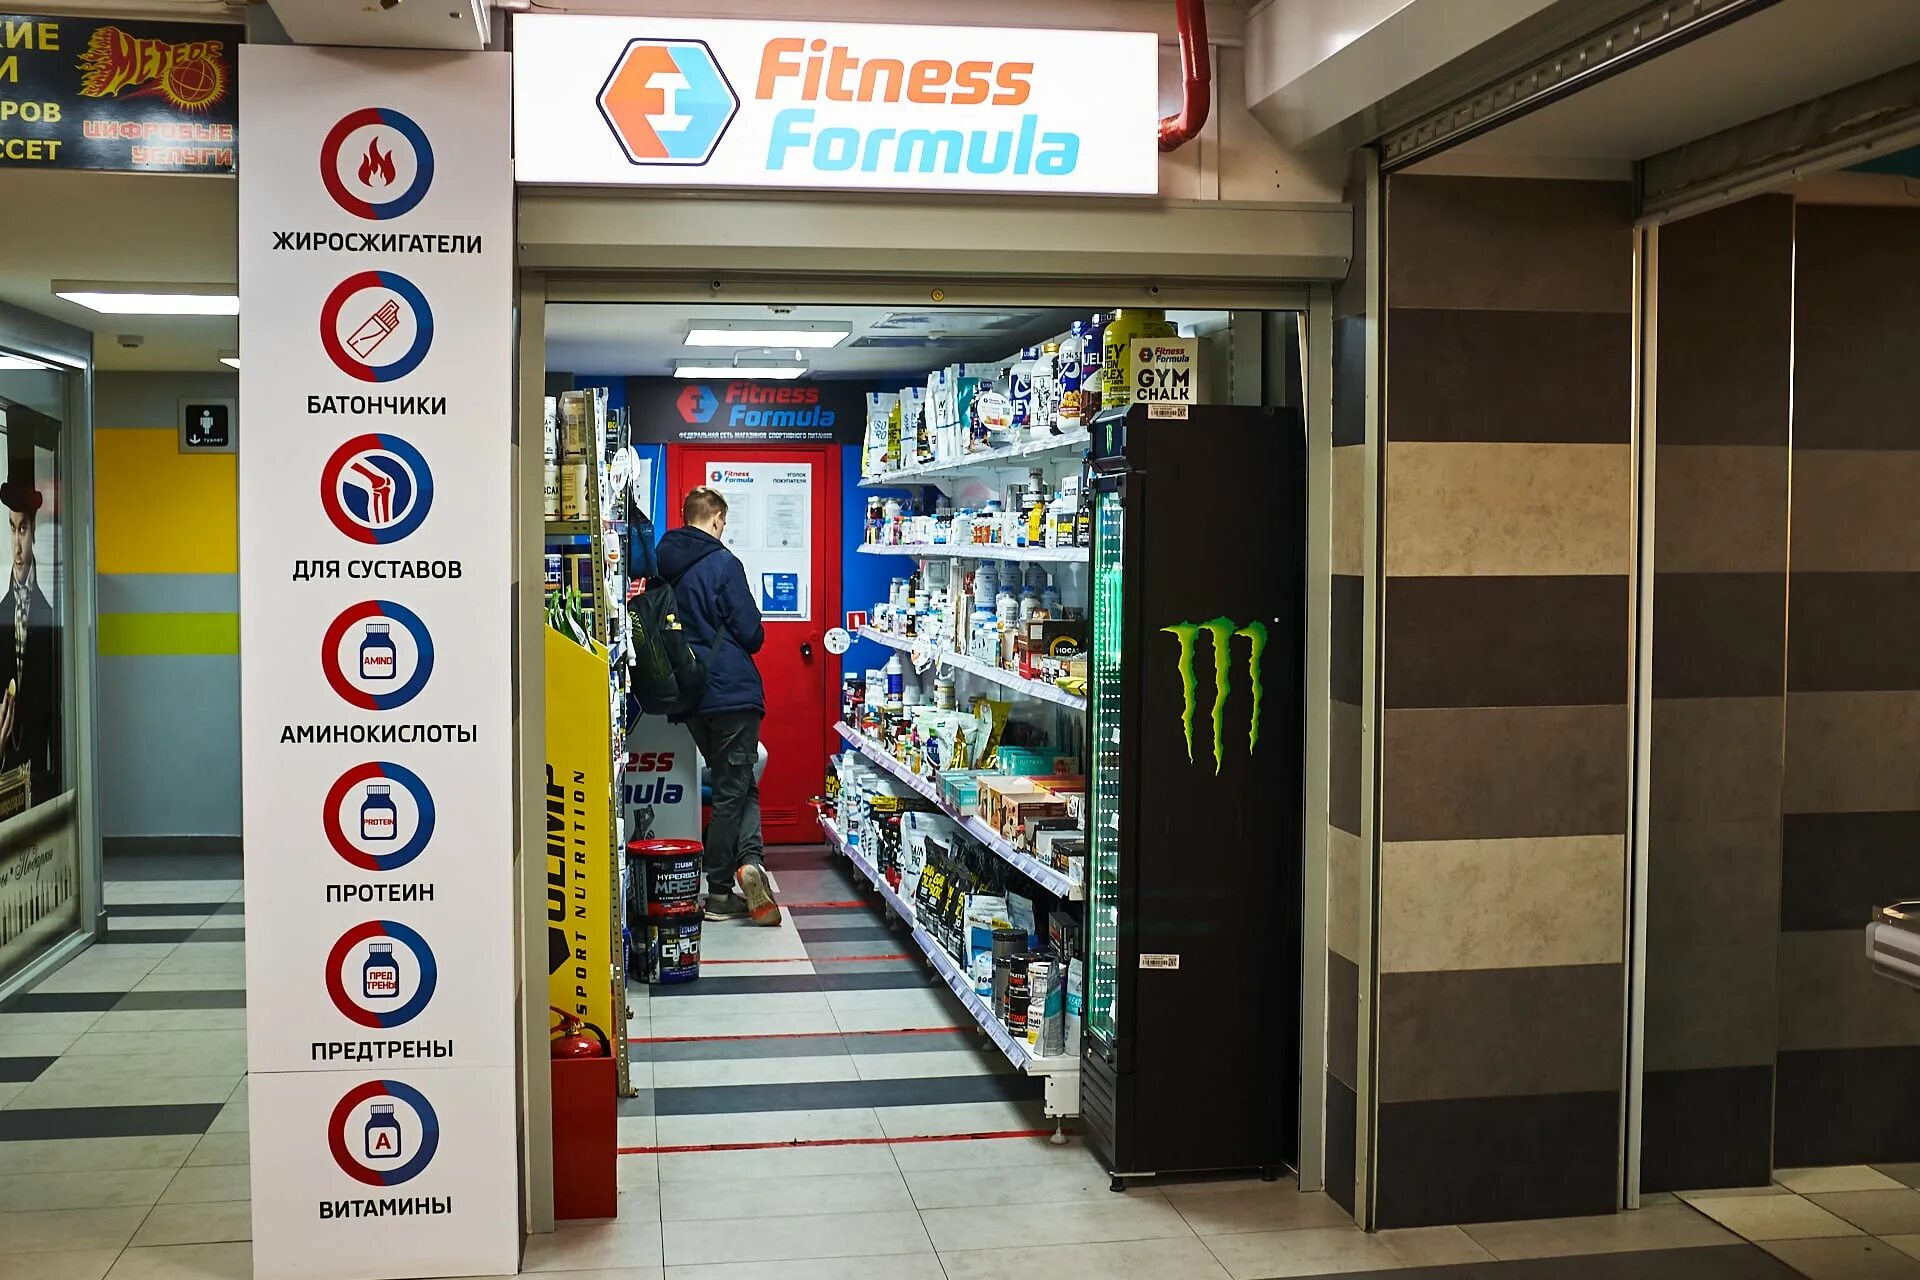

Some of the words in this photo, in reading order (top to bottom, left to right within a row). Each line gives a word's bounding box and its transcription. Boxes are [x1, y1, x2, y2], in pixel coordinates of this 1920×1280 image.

[0, 22, 60, 50] ИЕ
[755, 38, 1034, 106] Fitness
[83, 120, 233, 142] ЦИФРОВЫЕ
[0, 139, 62, 161] СЕТ
[766, 109, 1080, 176] Formula
[131, 145, 233, 166] УСЛУГИ
[273, 231, 482, 254] ЖИРОСЖИГАТЕЛИ
[1155, 346, 1185, 355] Fitness
[1156, 354, 1190, 363] Formula
[1138, 368, 1190, 388] GYM
[725, 381, 820, 404] Fitness
[1136, 388, 1190, 400] CHALK
[307, 395, 447, 415] БАТОНЧИКИ
[729, 404, 835, 427] Formula
[293, 560, 340, 582] ДЛЯ
[347, 560, 462, 579] СУСТАВОВ
[363, 655, 393, 666] AMINO
[280, 724, 477, 744] АМИНОКИСЛОТЫ
[363, 818, 394, 826] PROTEIN
[573, 771, 587, 919] NUTRITION
[326, 883, 434, 903] ПРОТЕИН
[369, 971, 393, 981] ПРЕД
[575, 931, 588, 1016] SPORT
[311, 1039, 454, 1063] ПРЕДТРЕНЫ
[319, 1196, 452, 1220] ВИТАМИНЫ
